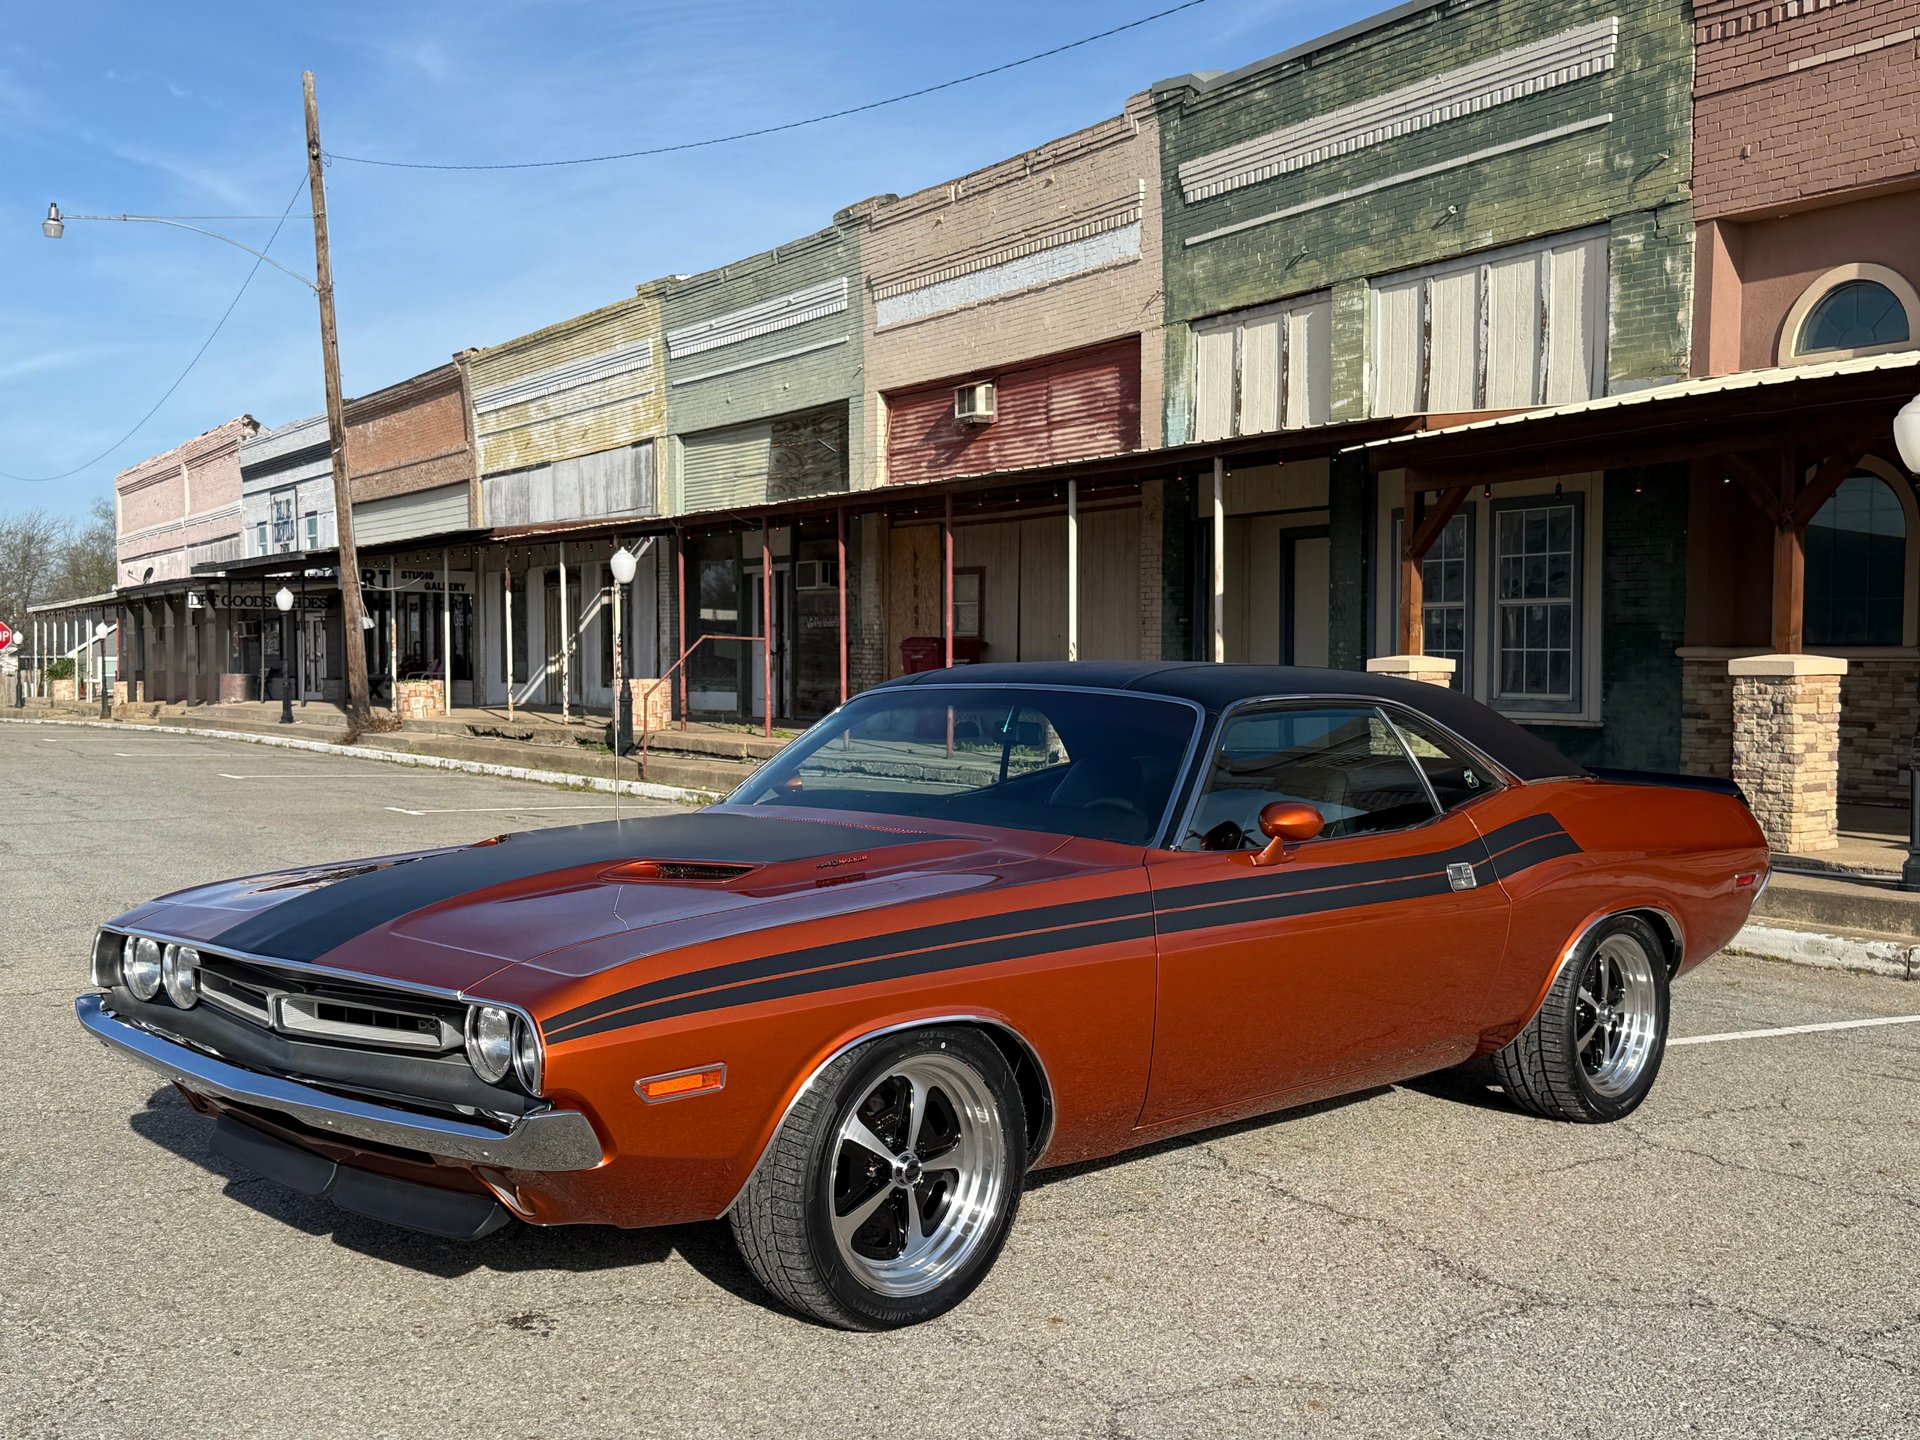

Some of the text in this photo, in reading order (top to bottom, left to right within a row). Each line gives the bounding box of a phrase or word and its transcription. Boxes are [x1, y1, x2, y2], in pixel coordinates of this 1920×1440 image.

[361, 569, 391, 589] RT
[400, 570, 434, 580] STUDIO
[221, 594, 272, 608] GOODS
[293, 596, 328, 609] HOES
[417, 1019, 440, 1030] DO
